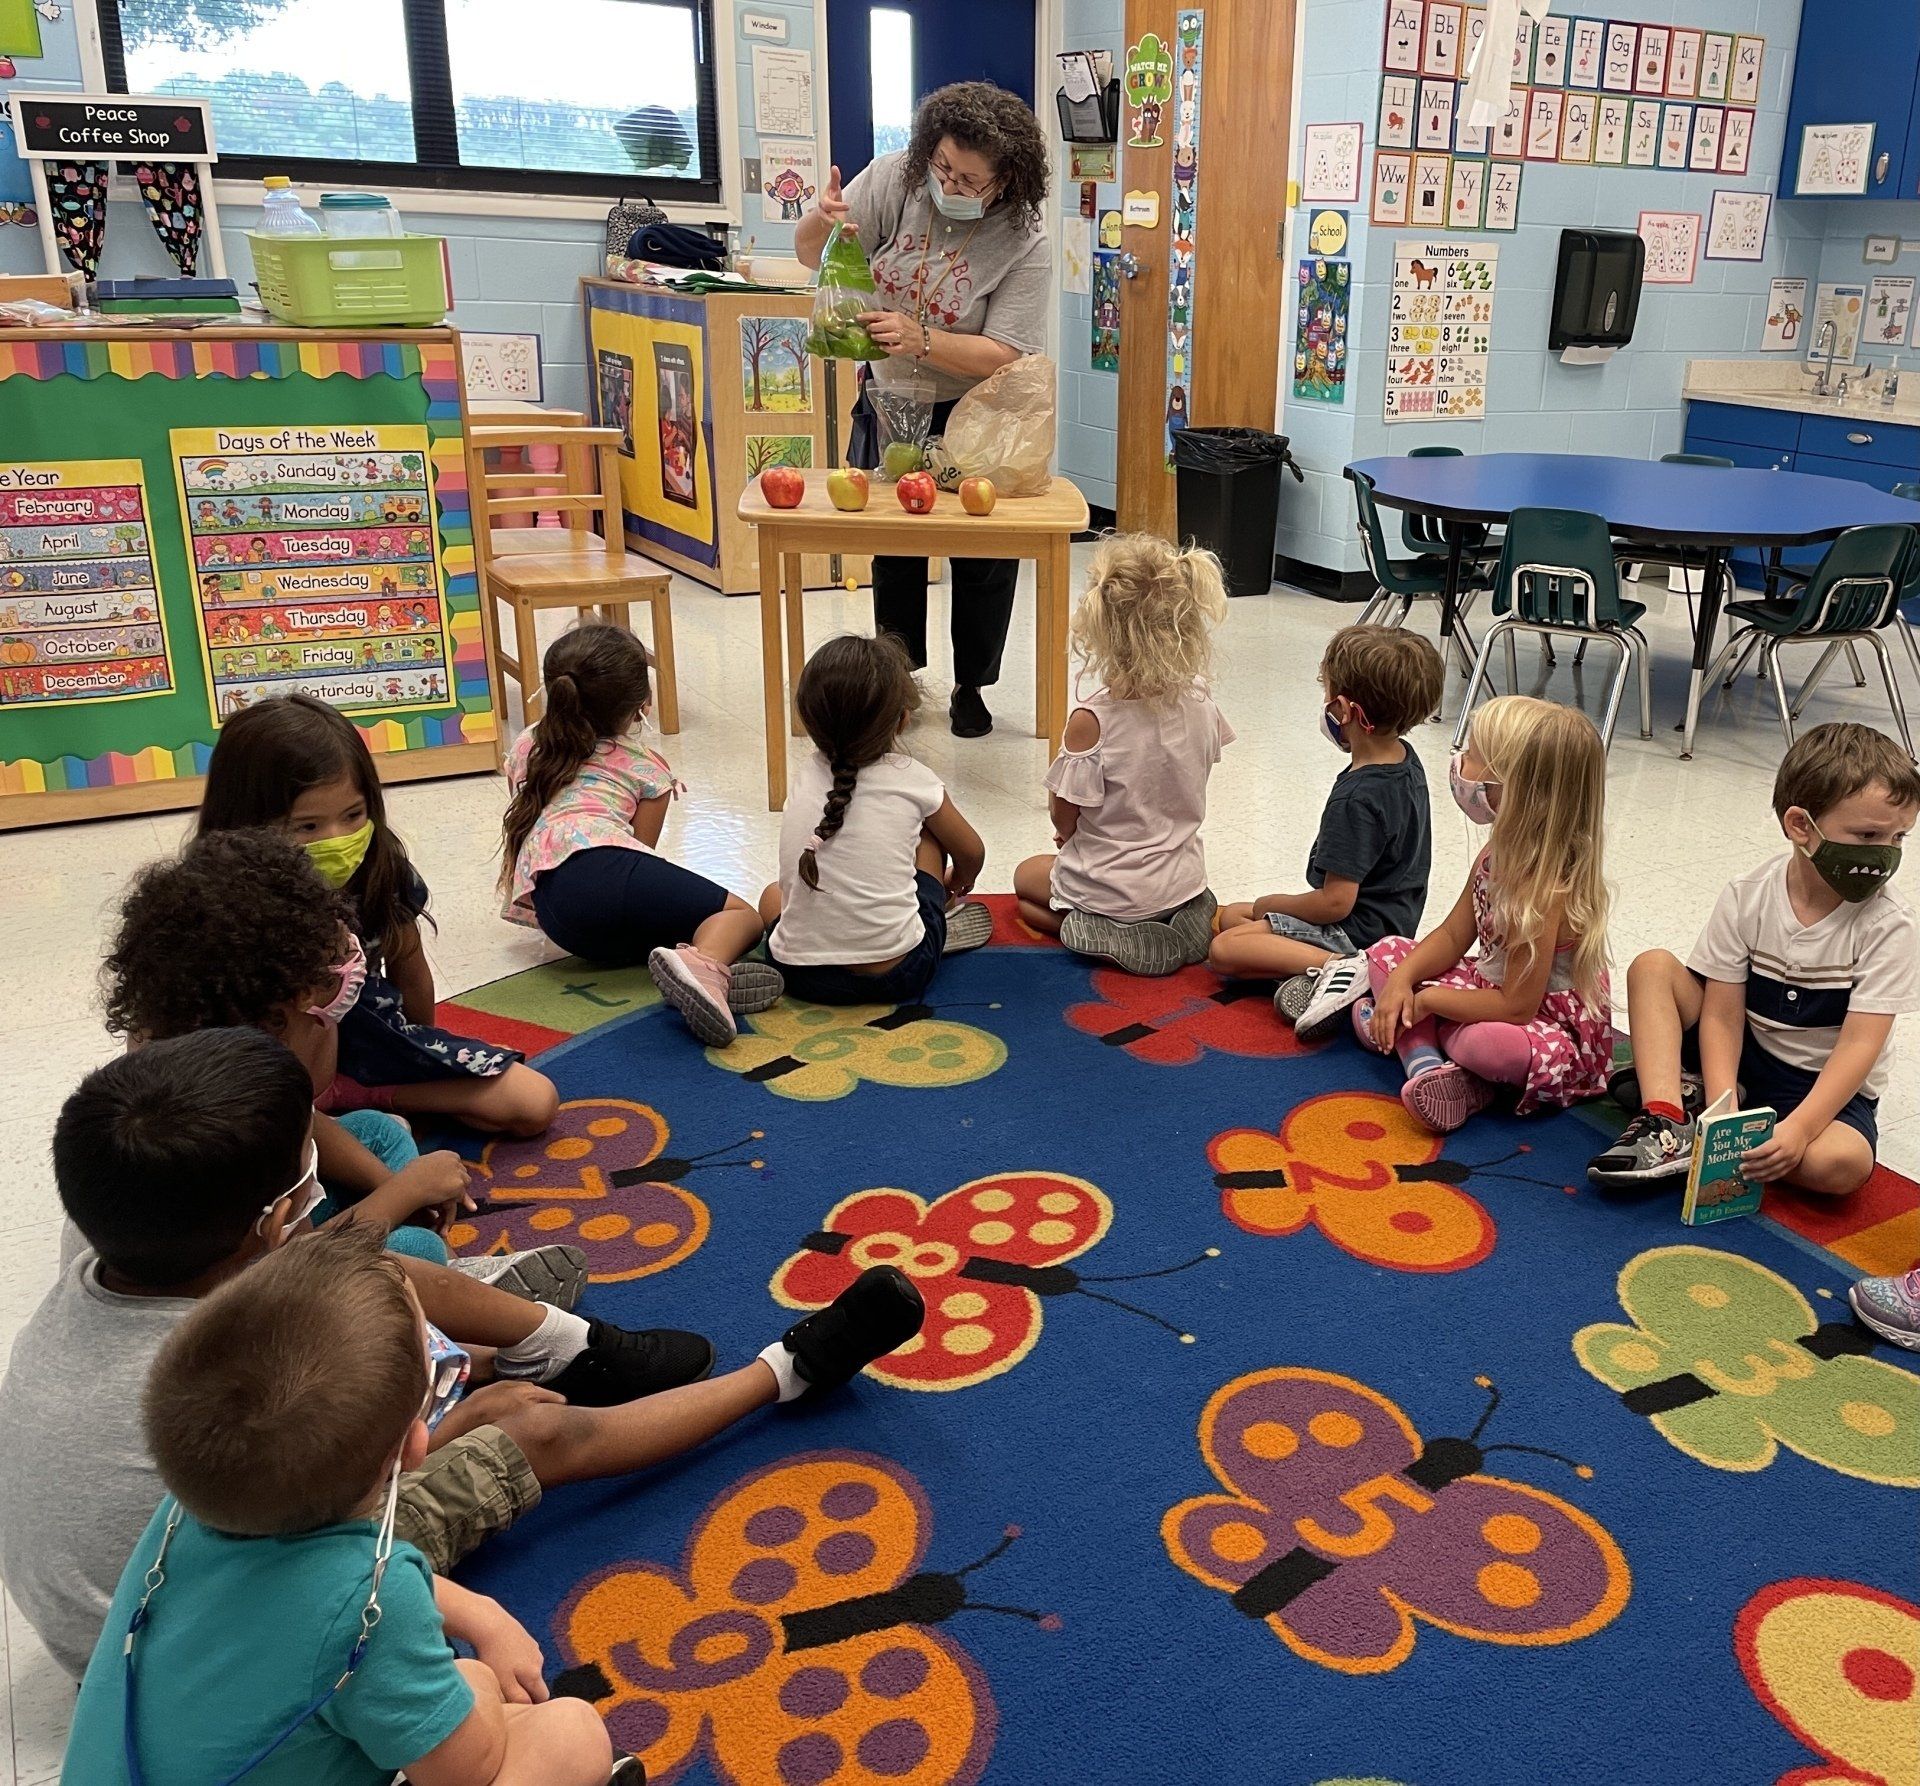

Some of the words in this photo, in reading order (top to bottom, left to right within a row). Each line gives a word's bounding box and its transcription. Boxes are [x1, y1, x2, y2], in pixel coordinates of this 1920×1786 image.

[751, 20, 778, 31] Window
[1393, 10, 1416, 30] Aa
[1435, 14, 1454, 34] Bb
[1472, 19, 1484, 38] C
[1545, 27, 1560, 46] Ee
[1580, 30, 1595, 48] Ff
[1612, 34, 1630, 57] Gg
[1645, 38, 1661, 56] Hh
[1711, 44, 1722, 70] Jj
[1740, 48, 1755, 65] Kk
[1130, 61, 1155, 73] WATCH
[1156, 61, 1168, 73] ME
[1392, 87, 1406, 107] Ll
[1423, 90, 1449, 110] Mm
[85, 106, 138, 122] Peace
[1537, 101, 1552, 128] Pp
[1569, 105, 1589, 131] Qq
[1604, 108, 1620, 126] Rr
[1637, 111, 1651, 129] Ss
[1671, 114, 1683, 132] Tt
[1700, 117, 1715, 134] Uu
[1732, 120, 1744, 137] Vv
[59, 127, 124, 144] Coffee
[129, 129, 170, 147] Shop
[1379, 164, 1406, 184] Ww
[1422, 167, 1439, 185] Xx
[1496, 173, 1512, 191] Zz
[1461, 171, 1475, 196] Yy
[1319, 225, 1343, 237] School
[1425, 245, 1469, 257] Numbers
[1873, 245, 1886, 253] Sink
[1448, 263, 1455, 278] 6
[1394, 280, 1409, 288] one
[1447, 279, 1457, 288] six
[1393, 295, 1401, 309] 2
[1446, 295, 1452, 310] 7
[1444, 312, 1466, 320] seven
[1391, 327, 1399, 342] 3
[1443, 327, 1450, 341] 8
[1390, 344, 1410, 352] three
[1441, 344, 1460, 353] eight
[1389, 359, 1396, 373] 4
[1440, 358, 1448, 372] 9
[1388, 376, 1403, 384] four
[1438, 375, 1455, 383] nine
[1386, 391, 1394, 405] 5
[1437, 390, 1448, 404] 10
[1386, 407, 1399, 416] five
[218, 433, 264, 452] Days
[270, 431, 290, 449] of
[296, 432, 326, 448] the
[332, 431, 375, 447] Week
[12, 469, 60, 486] Year
[277, 463, 336, 481] Sunday
[17, 500, 93, 515] February
[283, 503, 349, 520] Monday
[42, 534, 79, 552] April
[283, 537, 350, 553] Tuesday
[53, 572, 88, 585] June
[278, 571, 369, 590] Wednesday
[45, 600, 98, 619] August
[288, 609, 366, 627] Thursday
[45, 641, 115, 655] October
[303, 646, 353, 664] Friday
[45, 673, 125, 687] December
[1712, 1128, 1732, 1140] Are
[1712, 1140, 1730, 1152] You
[1733, 1135, 1753, 1148] My
[490, 1165, 607, 1200] 7
[1287, 1159, 1392, 1194] 2
[849, 1230, 959, 1278] 8
[1696, 1338, 1815, 1396] 3
[1293, 1472, 1435, 1558] 5
